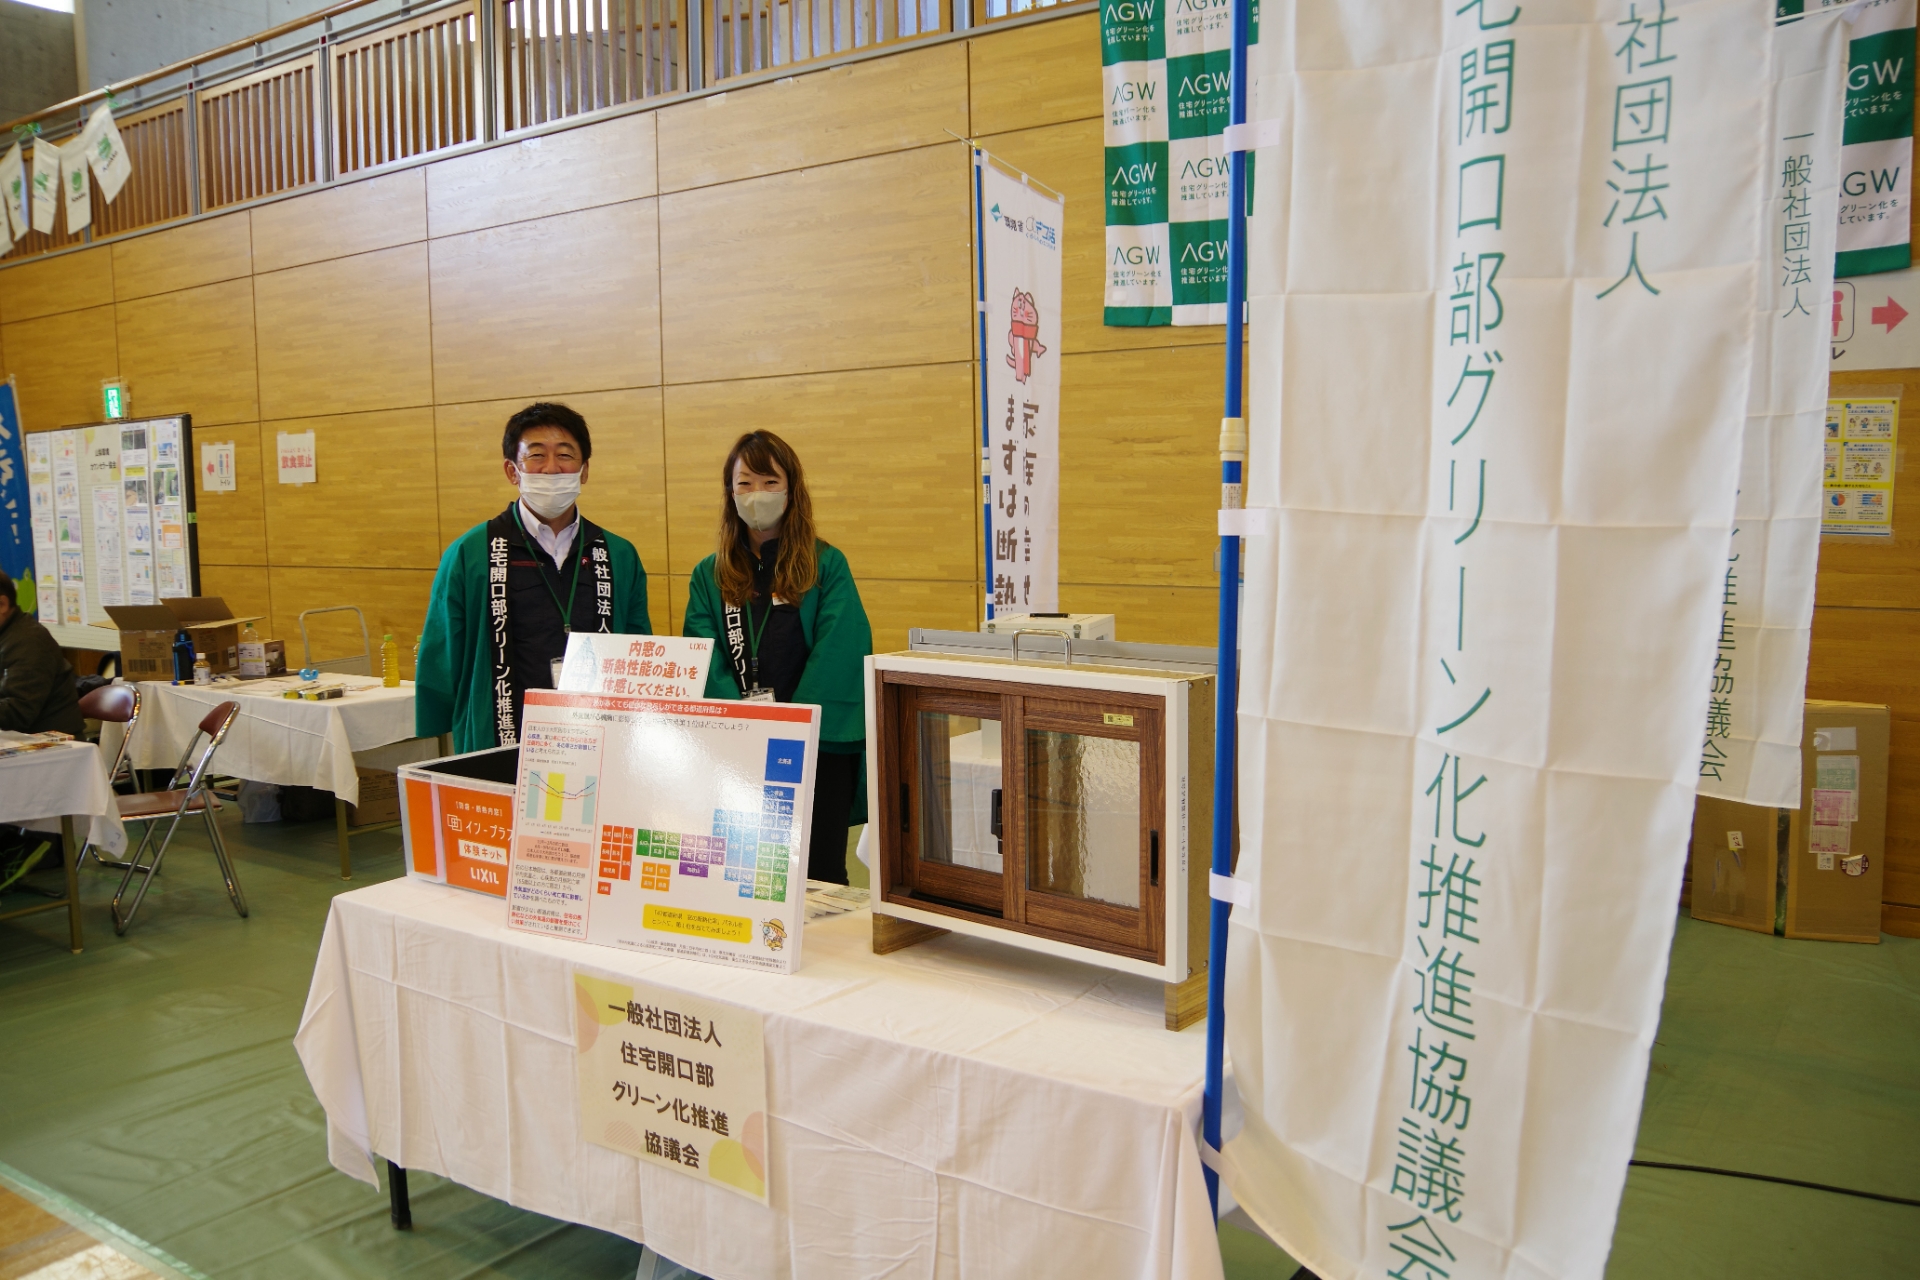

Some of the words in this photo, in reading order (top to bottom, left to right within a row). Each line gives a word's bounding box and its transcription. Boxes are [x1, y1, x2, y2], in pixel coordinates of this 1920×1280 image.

[1105, 1, 1154, 25] AGW
[1176, 11, 1229, 26] 住宅グリーン化を
[1178, 70, 1231, 97] AGW
[1846, 57, 1903, 91] GW
[1111, 81, 1156, 105] AGW
[1845, 91, 1902, 108] グリーン化を
[1112, 162, 1157, 185] AGW
[1839, 167, 1900, 197] GW
[1111, 187, 1157, 198] 住宅グリーン化を
[1181, 181, 1230, 193] 住宅グリーン化
[1840, 199, 1898, 214] グリーン化を
[1782, 133, 1814, 318] 一般社団法人
[1840, 212, 1890, 225] しています。
[1113, 245, 1160, 265] AGW
[1113, 270, 1161, 278] 住宅グリーン化を
[995, 394, 1019, 611] まずは断熱
[592, 538, 612, 634] 一般社団法人
[489, 537, 517, 747] 住宅開口部グリーン化推進協
[628, 640, 666, 658] 内窓の
[689, 642, 708, 651] LIXIL
[725, 601, 748, 692] 開口部グリー
[602, 658, 698, 680] 断熱性能の違いを
[602, 677, 691, 698] 体感してください。
[463, 843, 502, 860] 体験キット
[470, 866, 500, 885] LIXIL
[608, 1000, 722, 1047] 一般社団法人
[620, 1041, 714, 1088] 住宅開口部
[612, 1080, 729, 1137] グリーン化推進
[645, 1129, 699, 1169] 協議会
